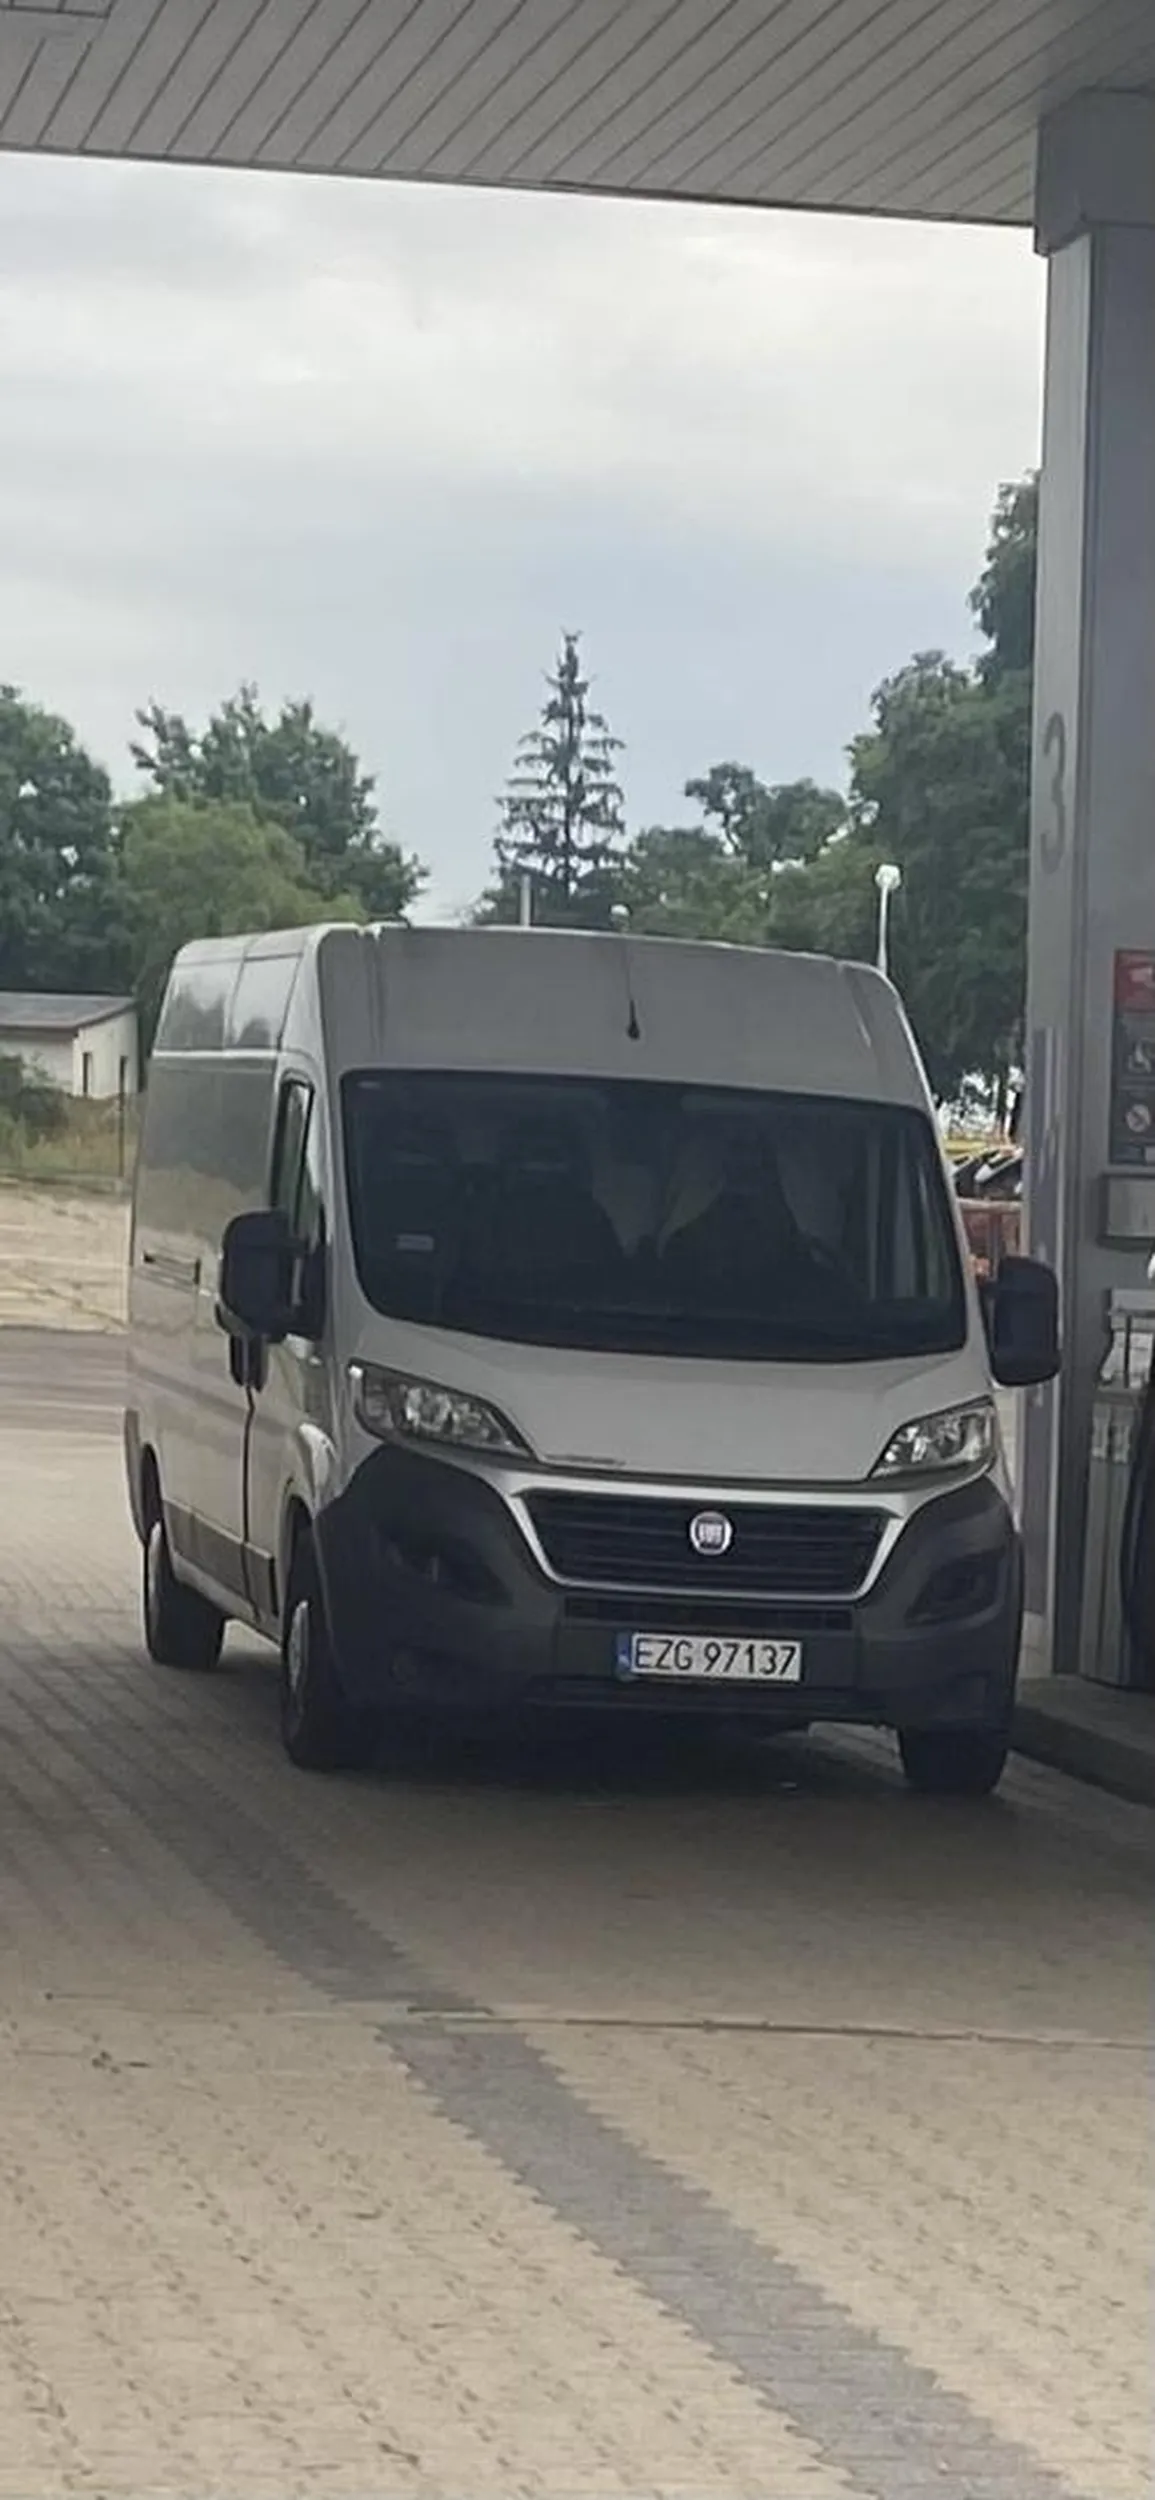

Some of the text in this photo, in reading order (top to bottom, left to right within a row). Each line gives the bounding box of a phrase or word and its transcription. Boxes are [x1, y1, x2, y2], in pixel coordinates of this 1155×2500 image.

[1040, 711, 1066, 874] 3
[634, 1637, 693, 1671] EZG
[702, 1640, 797, 1676] 97137
